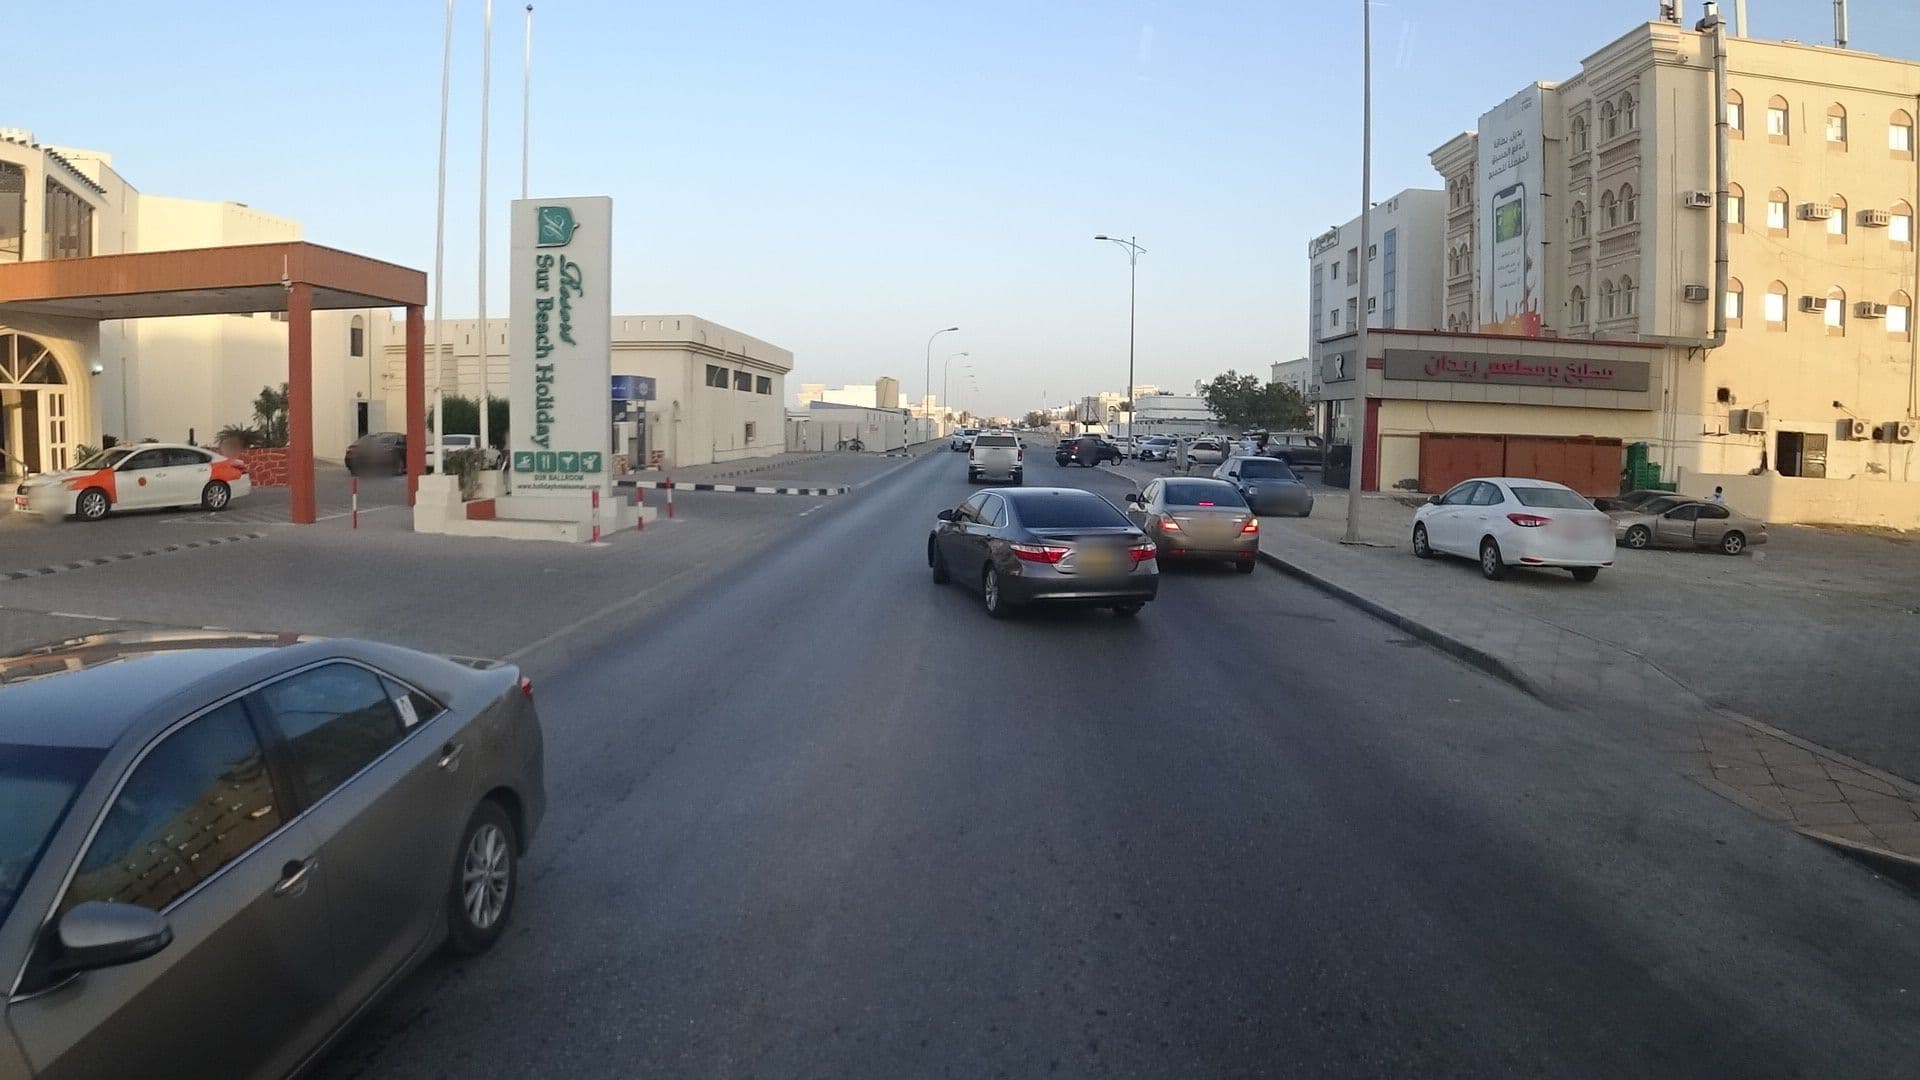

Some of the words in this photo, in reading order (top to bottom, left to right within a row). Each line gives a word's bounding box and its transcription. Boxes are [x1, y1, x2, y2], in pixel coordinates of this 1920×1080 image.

[535, 254, 555, 292] Sur
[535, 296, 555, 358] Beach
[530, 363, 555, 449] Holiday
